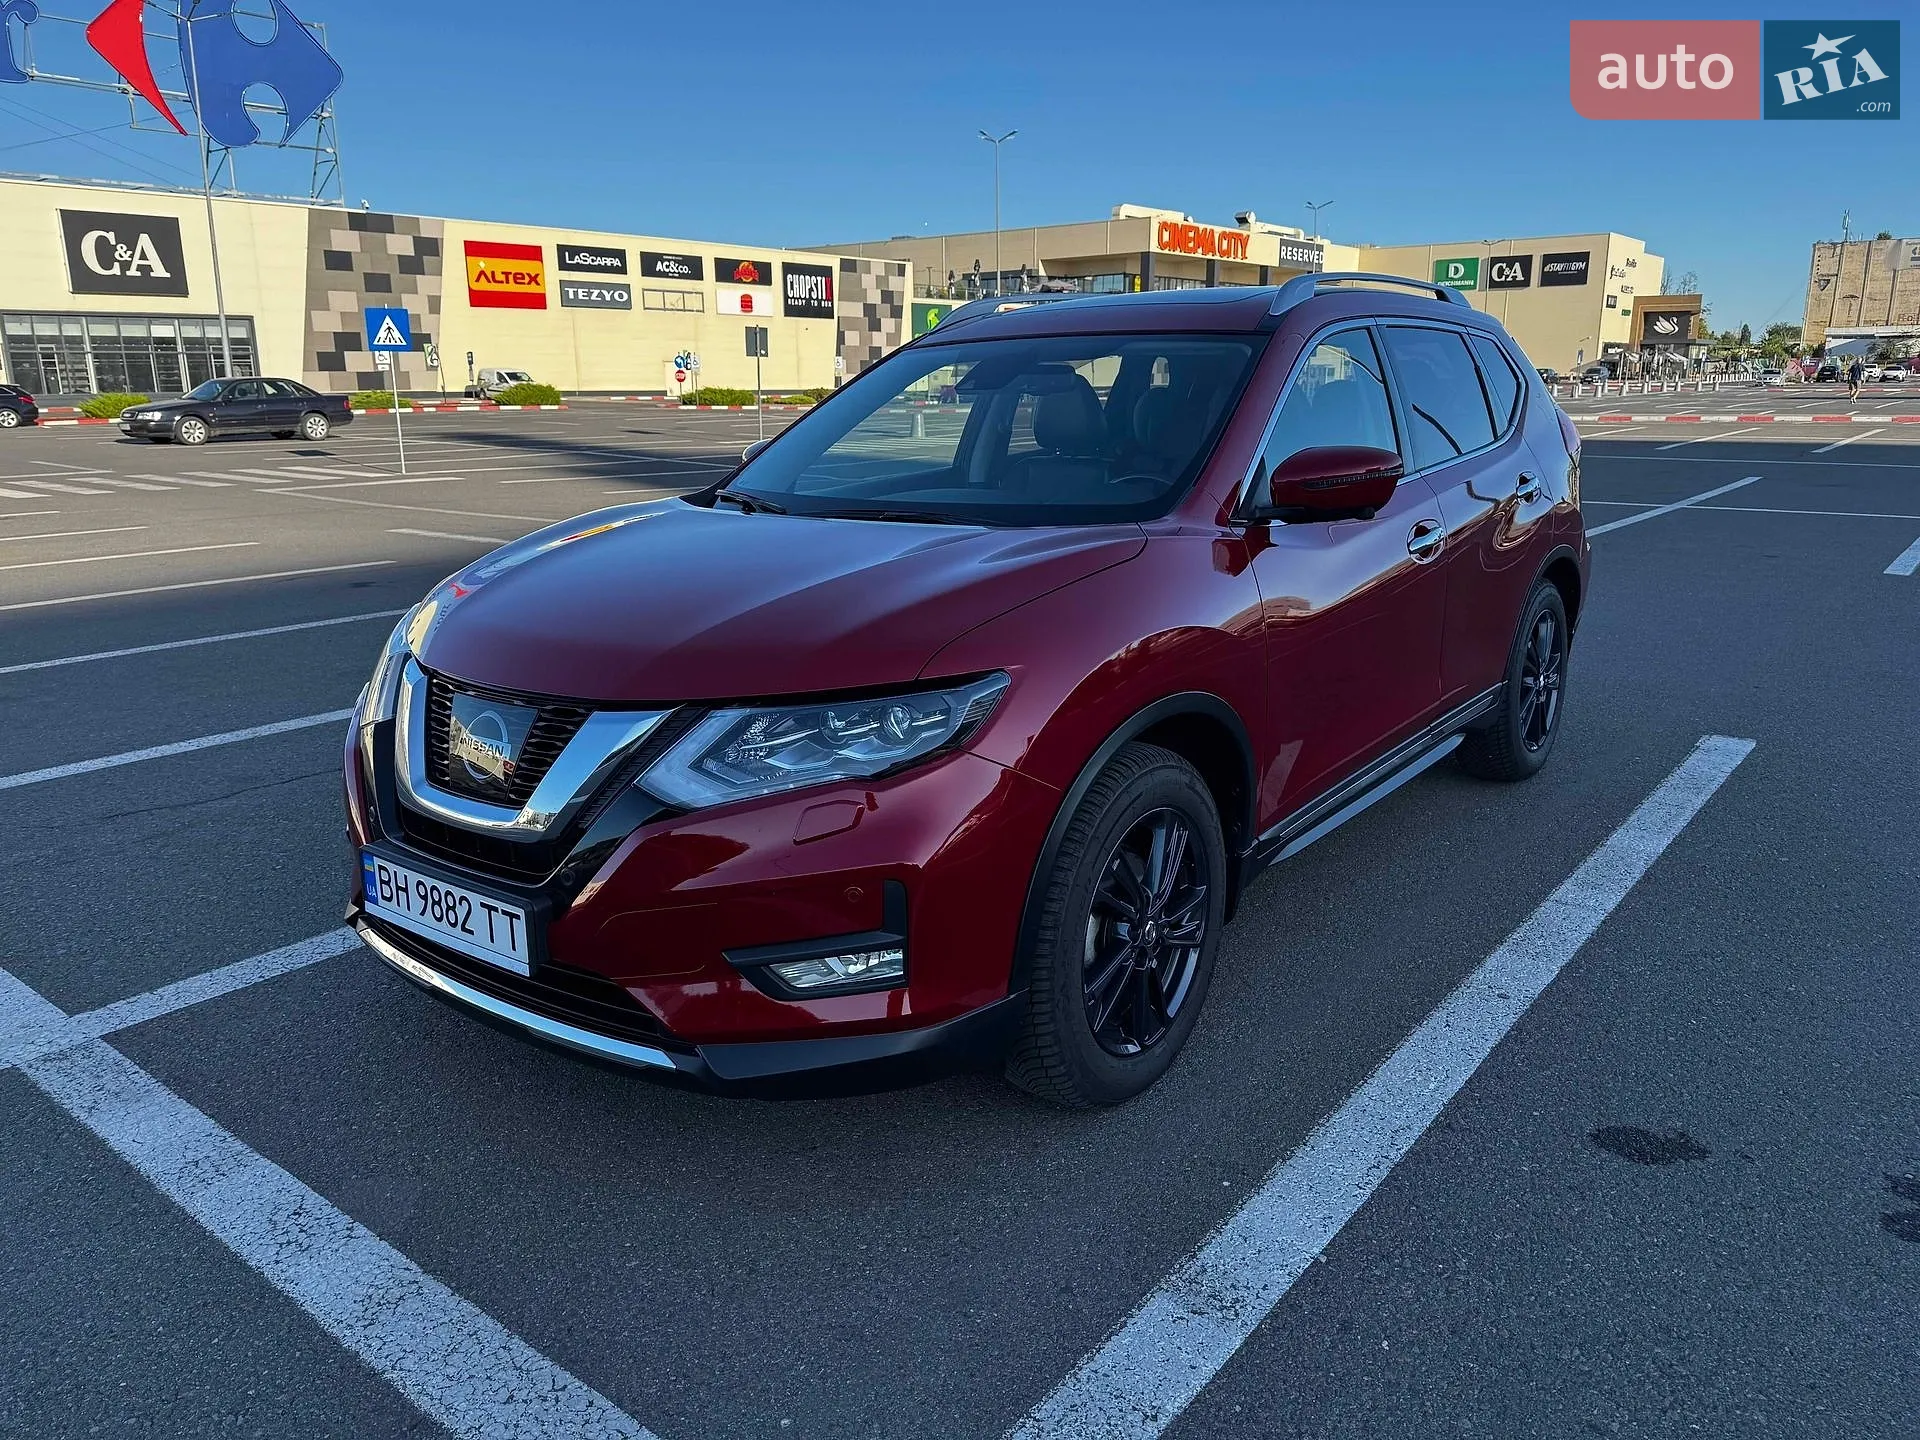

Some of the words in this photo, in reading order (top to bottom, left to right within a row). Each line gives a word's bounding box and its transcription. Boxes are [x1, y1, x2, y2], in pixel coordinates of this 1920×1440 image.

[1157, 220, 1217, 257] CINEMA
[1217, 230, 1250, 261] CITY
[80, 229, 171, 279] C&A
[1280, 246, 1324, 264] RESERVED
[1448, 263, 1465, 279] D
[1491, 262, 1525, 282] C&A
[564, 287, 629, 302] TEZYO
[786, 273, 833, 300] CHOPSTIX
[459, 737, 505, 757] NISSAN
[366, 883, 378, 899] UA
[377, 863, 411, 912] BH
[415, 879, 475, 936] 9882
[479, 901, 521, 952] TT
